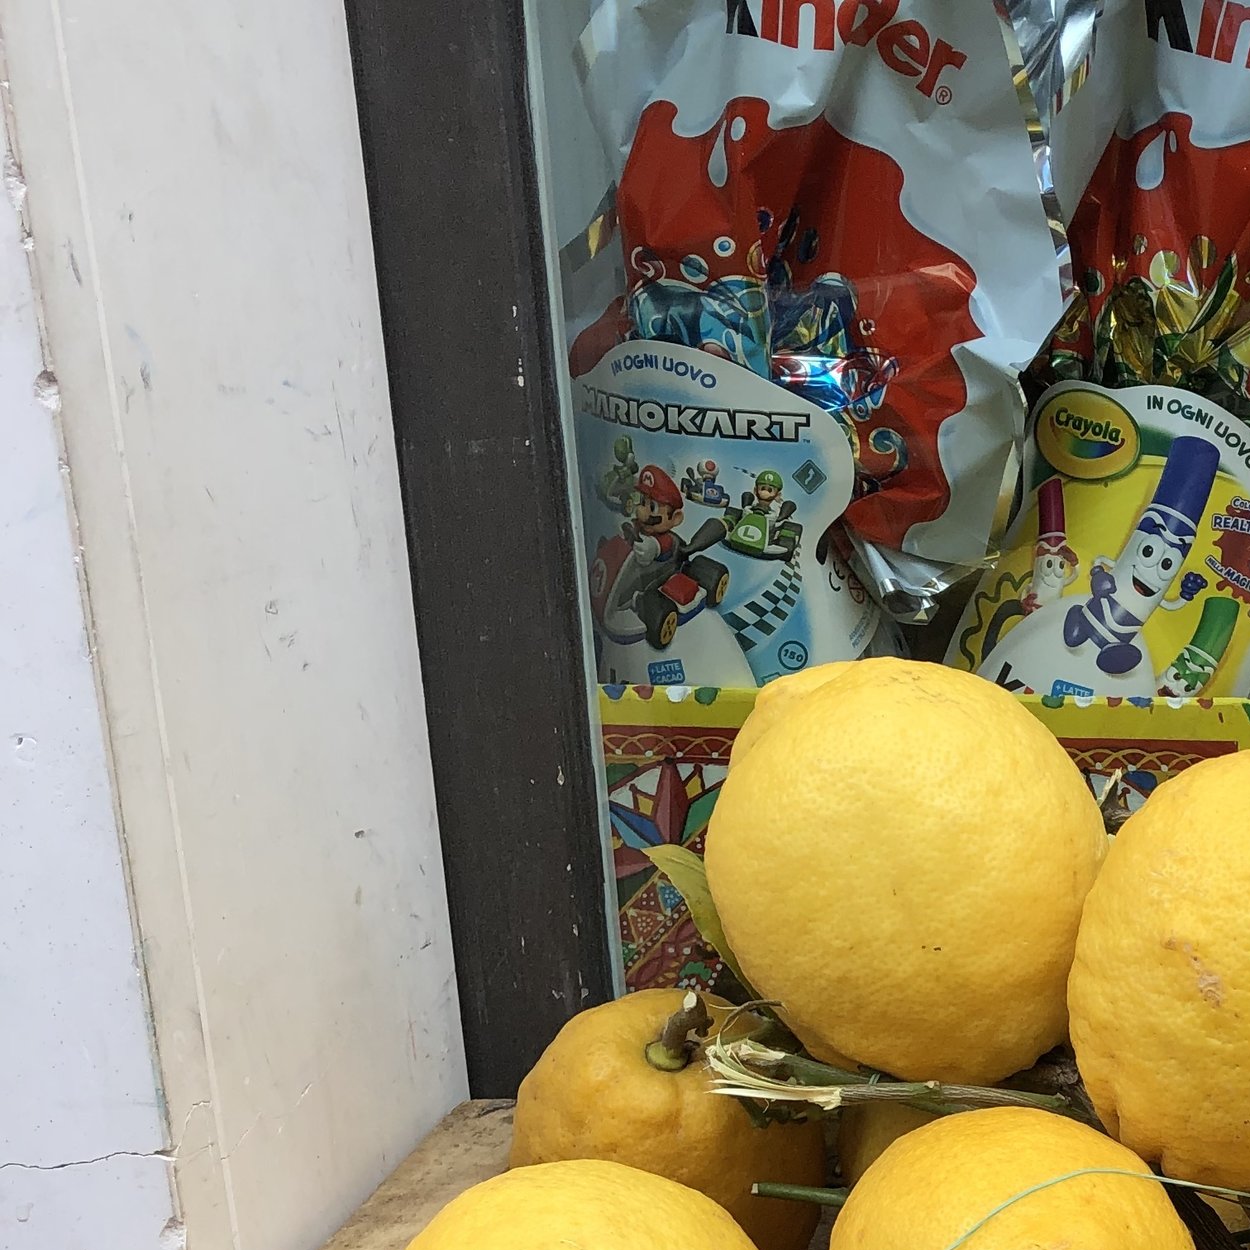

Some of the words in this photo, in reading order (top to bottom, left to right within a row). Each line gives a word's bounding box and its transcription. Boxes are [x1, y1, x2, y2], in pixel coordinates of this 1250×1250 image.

[611, 359, 622, 376] IN
[622, 353, 658, 371] OGNI
[663, 355, 717, 389] UOVO
[1054, 407, 1124, 443] Crayola
[1147, 395, 1164, 411] IN
[1167, 399, 1214, 429] OGNI
[1207, 557, 1224, 574] NELLA
